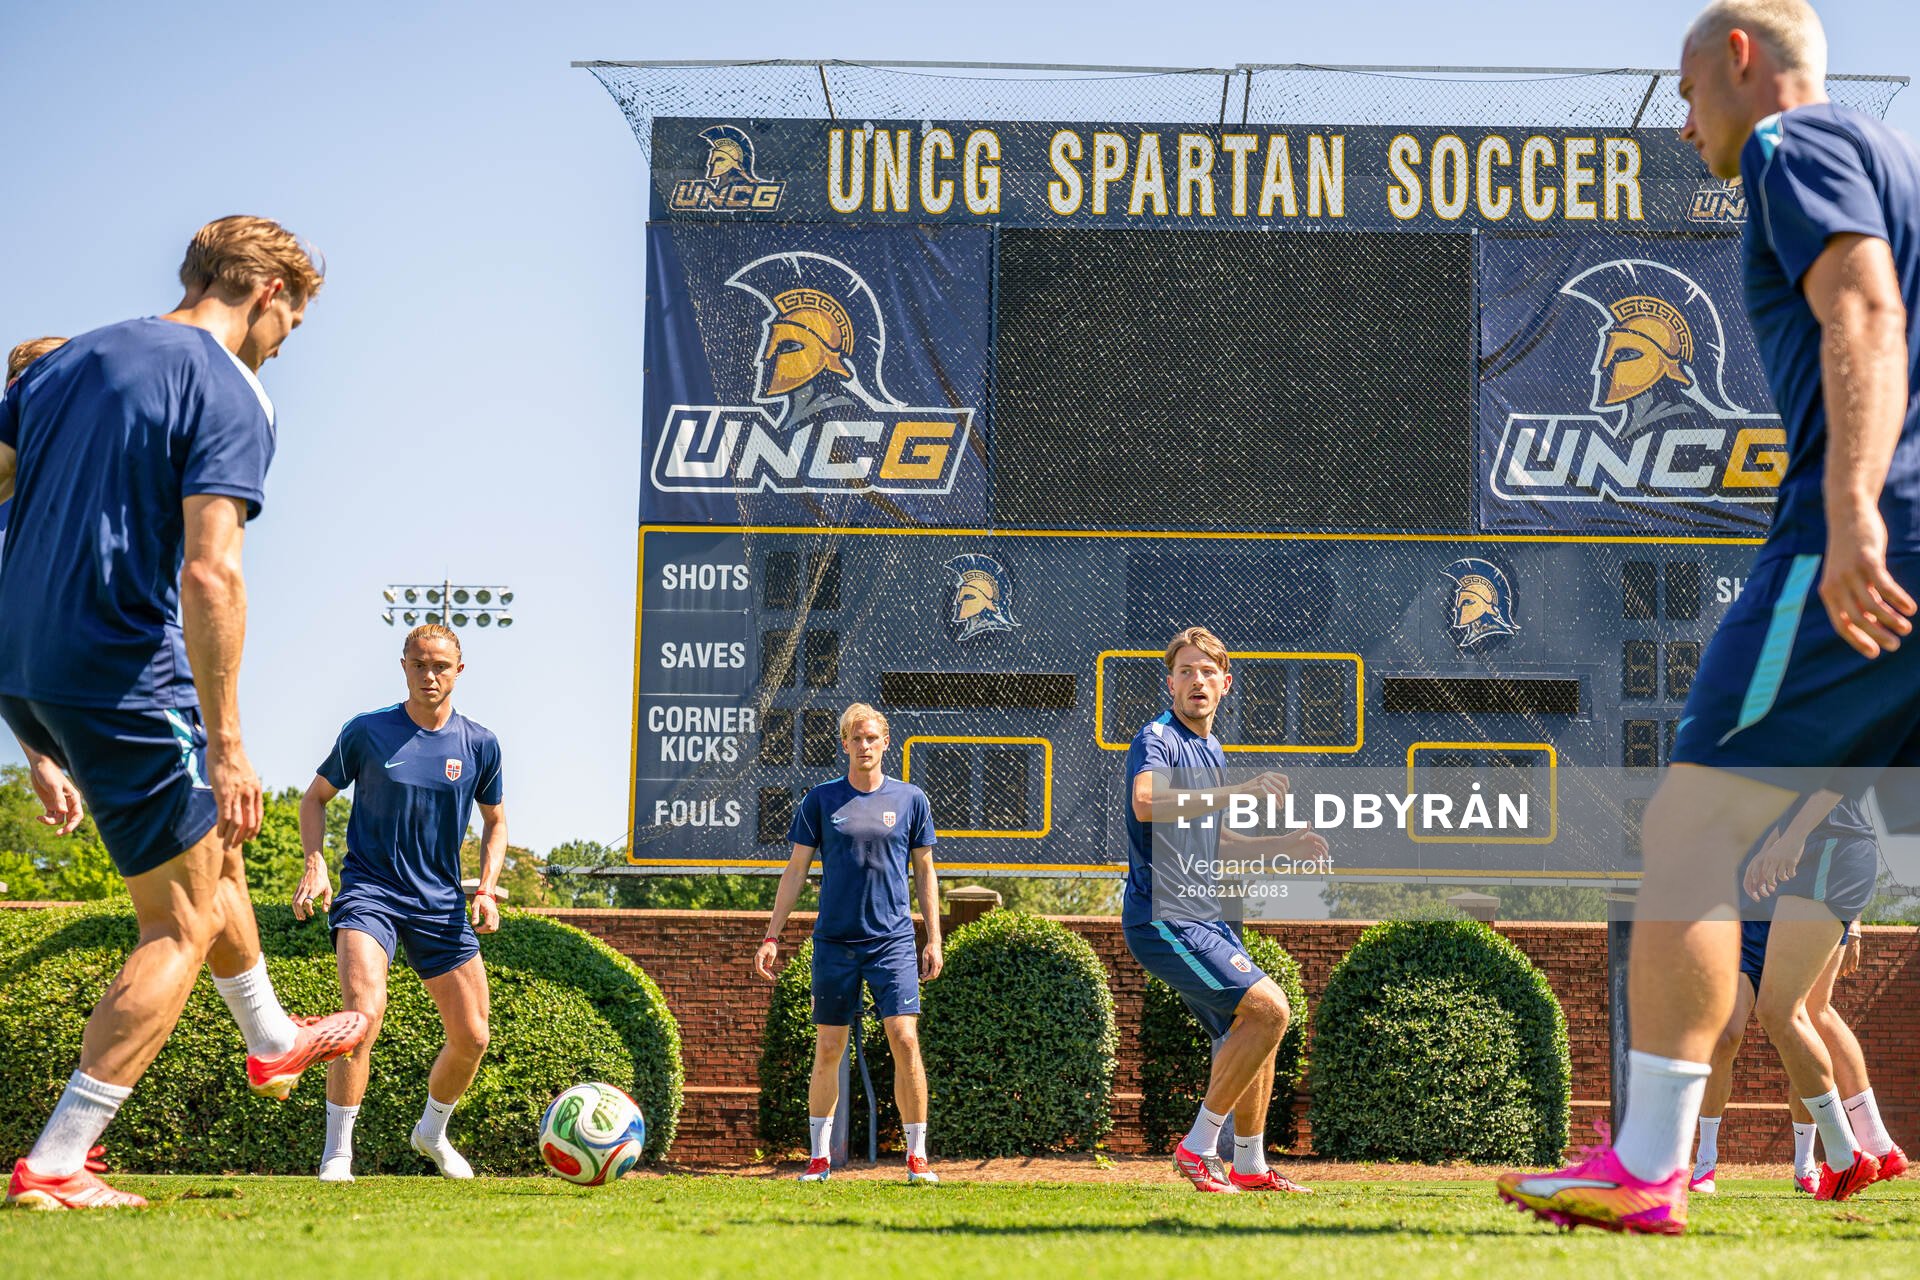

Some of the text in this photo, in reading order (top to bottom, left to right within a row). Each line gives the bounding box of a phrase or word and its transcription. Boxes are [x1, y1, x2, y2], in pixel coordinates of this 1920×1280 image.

[828, 129, 1645, 222] UNCG SPARTAN SOCCER
[676, 185, 780, 208] UNCG
[1692, 195, 1748, 217] UN
[665, 420, 957, 479] UNCG
[1505, 428, 1787, 488] UNCG
[662, 564, 749, 591] SHOTS
[660, 642, 746, 669] SAVES
[648, 705, 756, 733] CORNER
[660, 735, 738, 762] KICKS
[654, 799, 741, 827] FOULS
